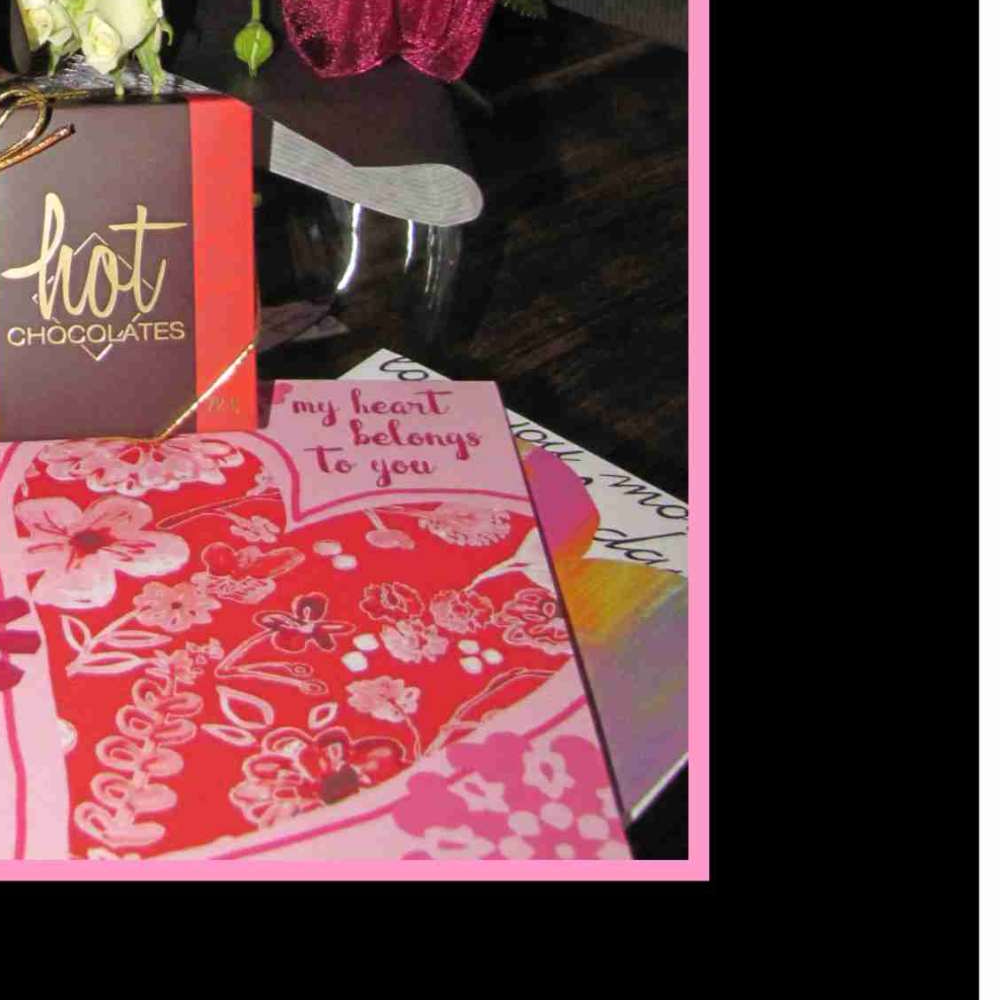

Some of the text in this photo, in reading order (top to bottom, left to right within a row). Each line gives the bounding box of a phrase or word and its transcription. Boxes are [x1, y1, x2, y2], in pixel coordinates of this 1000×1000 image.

[1, 192, 187, 320] hot
[7, 321, 185, 346] CHOCOLATES
[292, 388, 452, 427] my heart
[350, 419, 482, 460] belongs
[304, 446, 434, 488] to you
